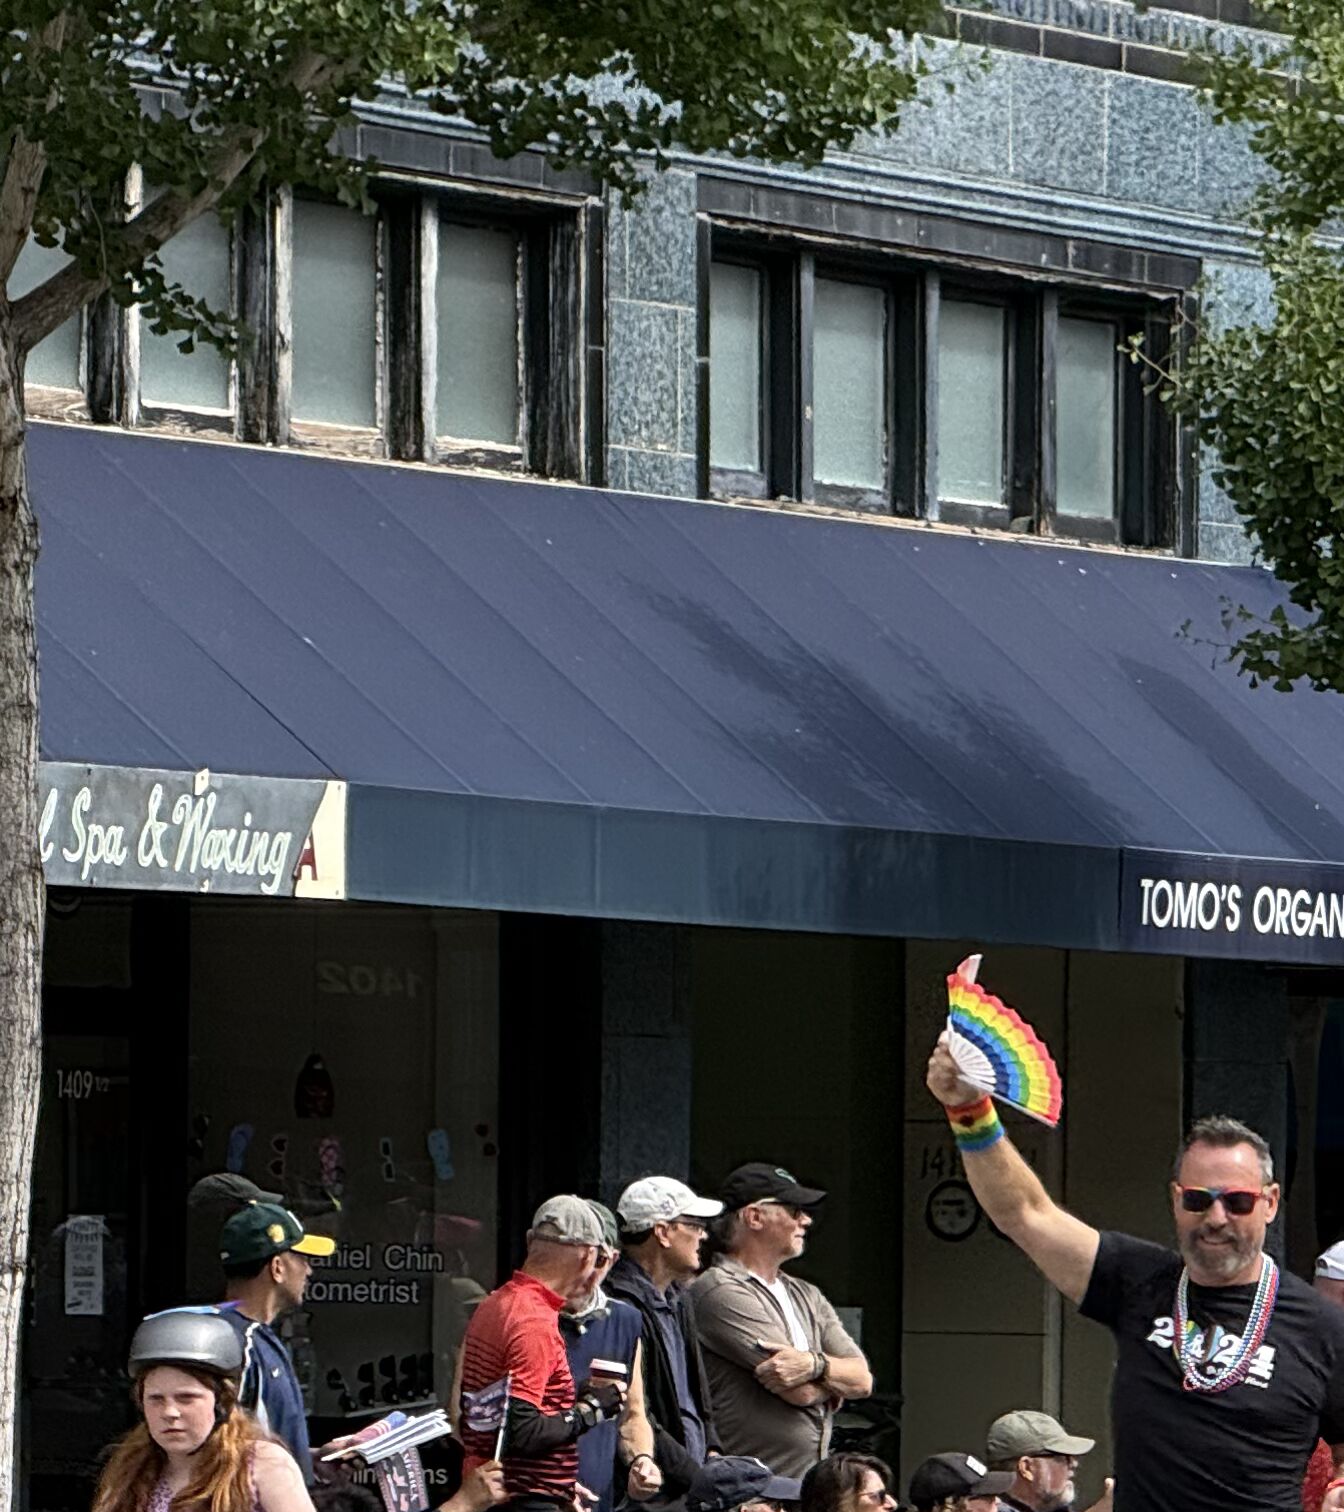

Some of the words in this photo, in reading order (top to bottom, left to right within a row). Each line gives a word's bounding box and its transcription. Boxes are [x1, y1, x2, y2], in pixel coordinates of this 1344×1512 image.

[62, 786, 127, 880] Spa
[138, 783, 168, 867] &
[172, 792, 292, 895] Waxing
[1140, 878, 1241, 932] TOMO'S
[57, 1069, 94, 1099] 1409
[310, 1244, 371, 1270] aniel
[384, 1243, 444, 1271] Chin
[302, 1278, 420, 1303] tometrist
